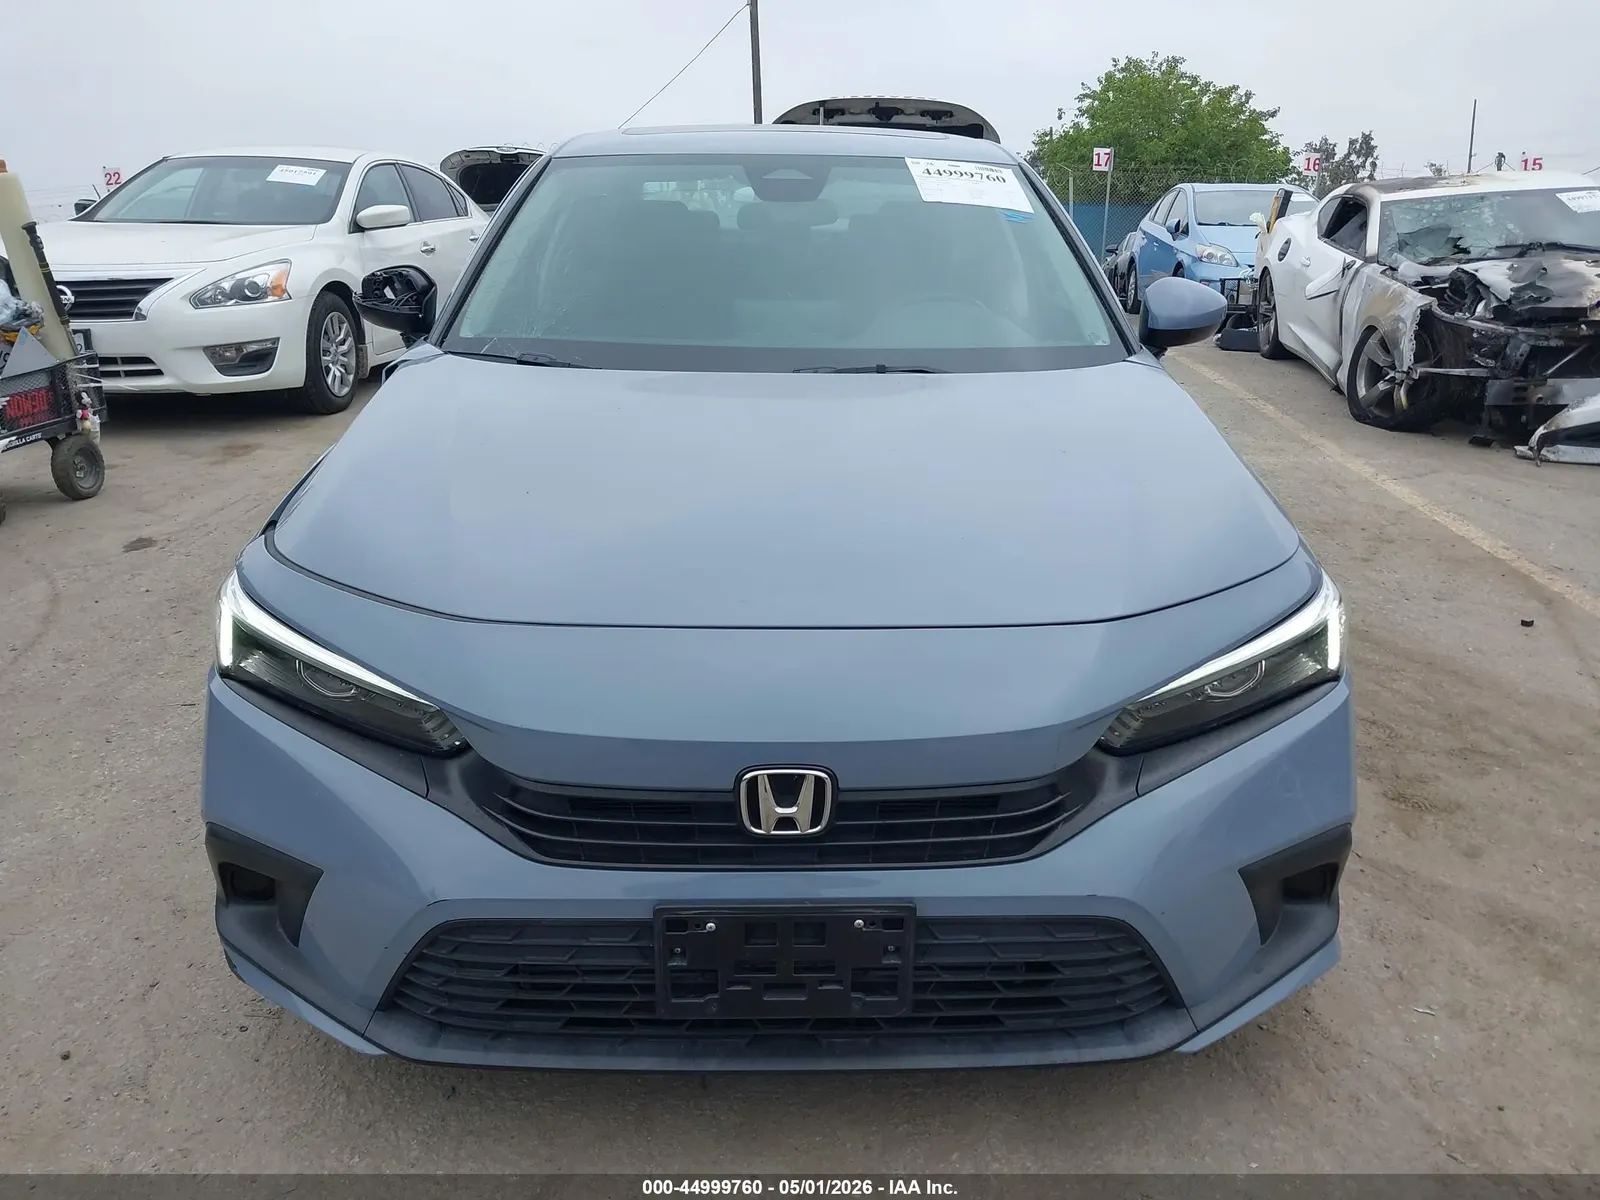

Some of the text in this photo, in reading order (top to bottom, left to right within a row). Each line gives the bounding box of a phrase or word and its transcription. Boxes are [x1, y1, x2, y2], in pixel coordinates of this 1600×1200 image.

[1094, 152, 1111, 167] 17
[1304, 157, 1321, 172] 16
[1521, 157, 1543, 171] 15
[104, 171, 122, 186] 22
[922, 168, 1007, 183] 44999760
[26, 432, 42, 442] CARTS
